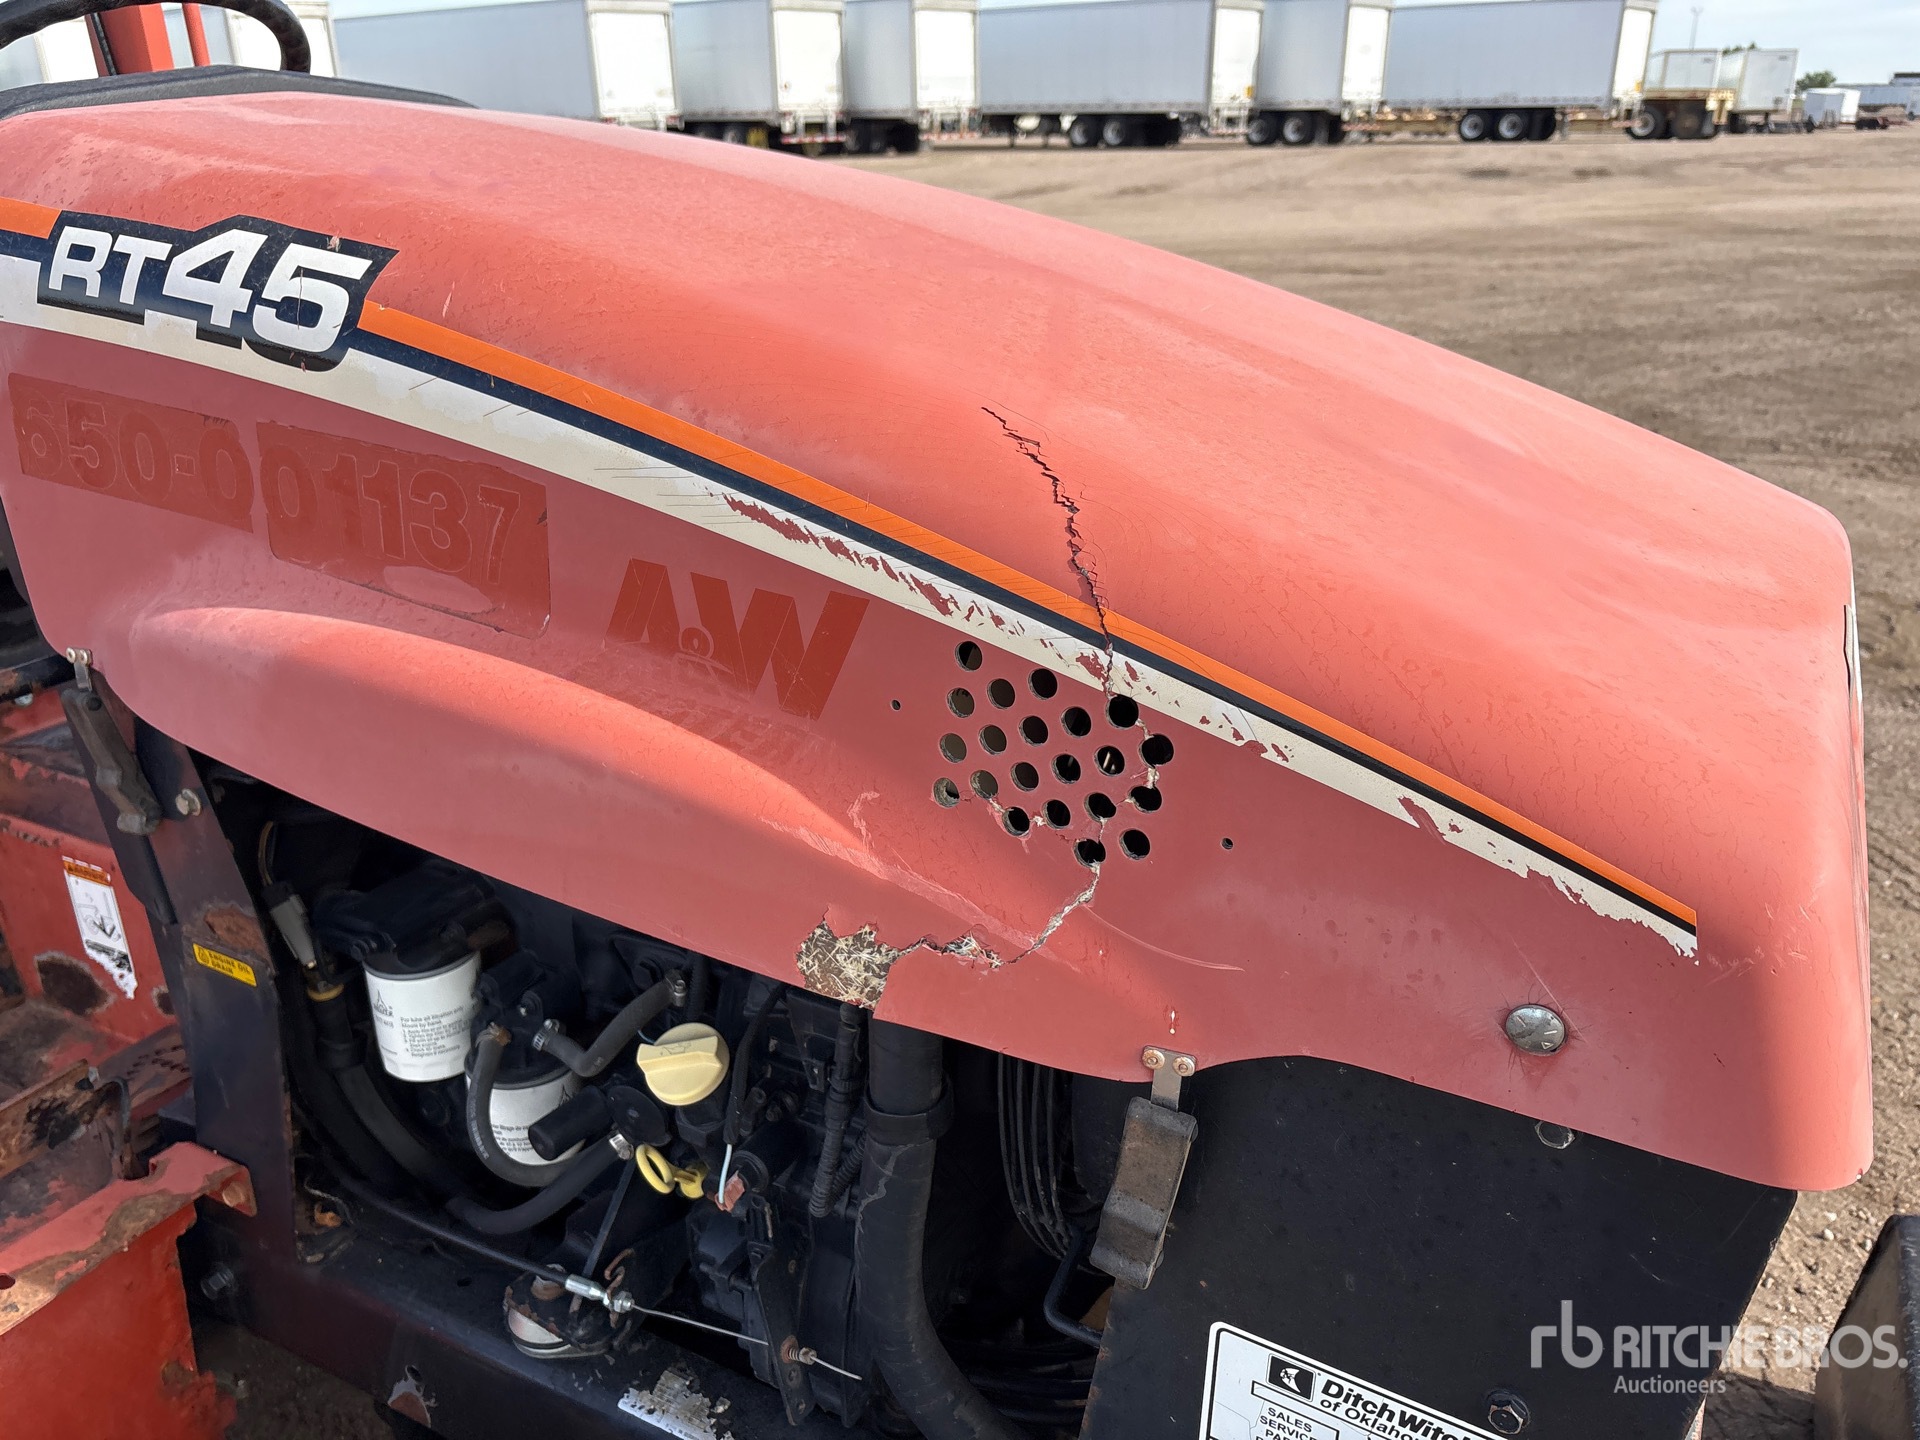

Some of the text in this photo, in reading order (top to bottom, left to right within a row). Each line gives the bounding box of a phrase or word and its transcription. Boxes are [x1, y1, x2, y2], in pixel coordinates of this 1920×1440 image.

[48, 225, 374, 354] RT45
[1267, 1407, 1313, 1433] SALES
[1319, 1399, 1420, 1440] of Oklaho
